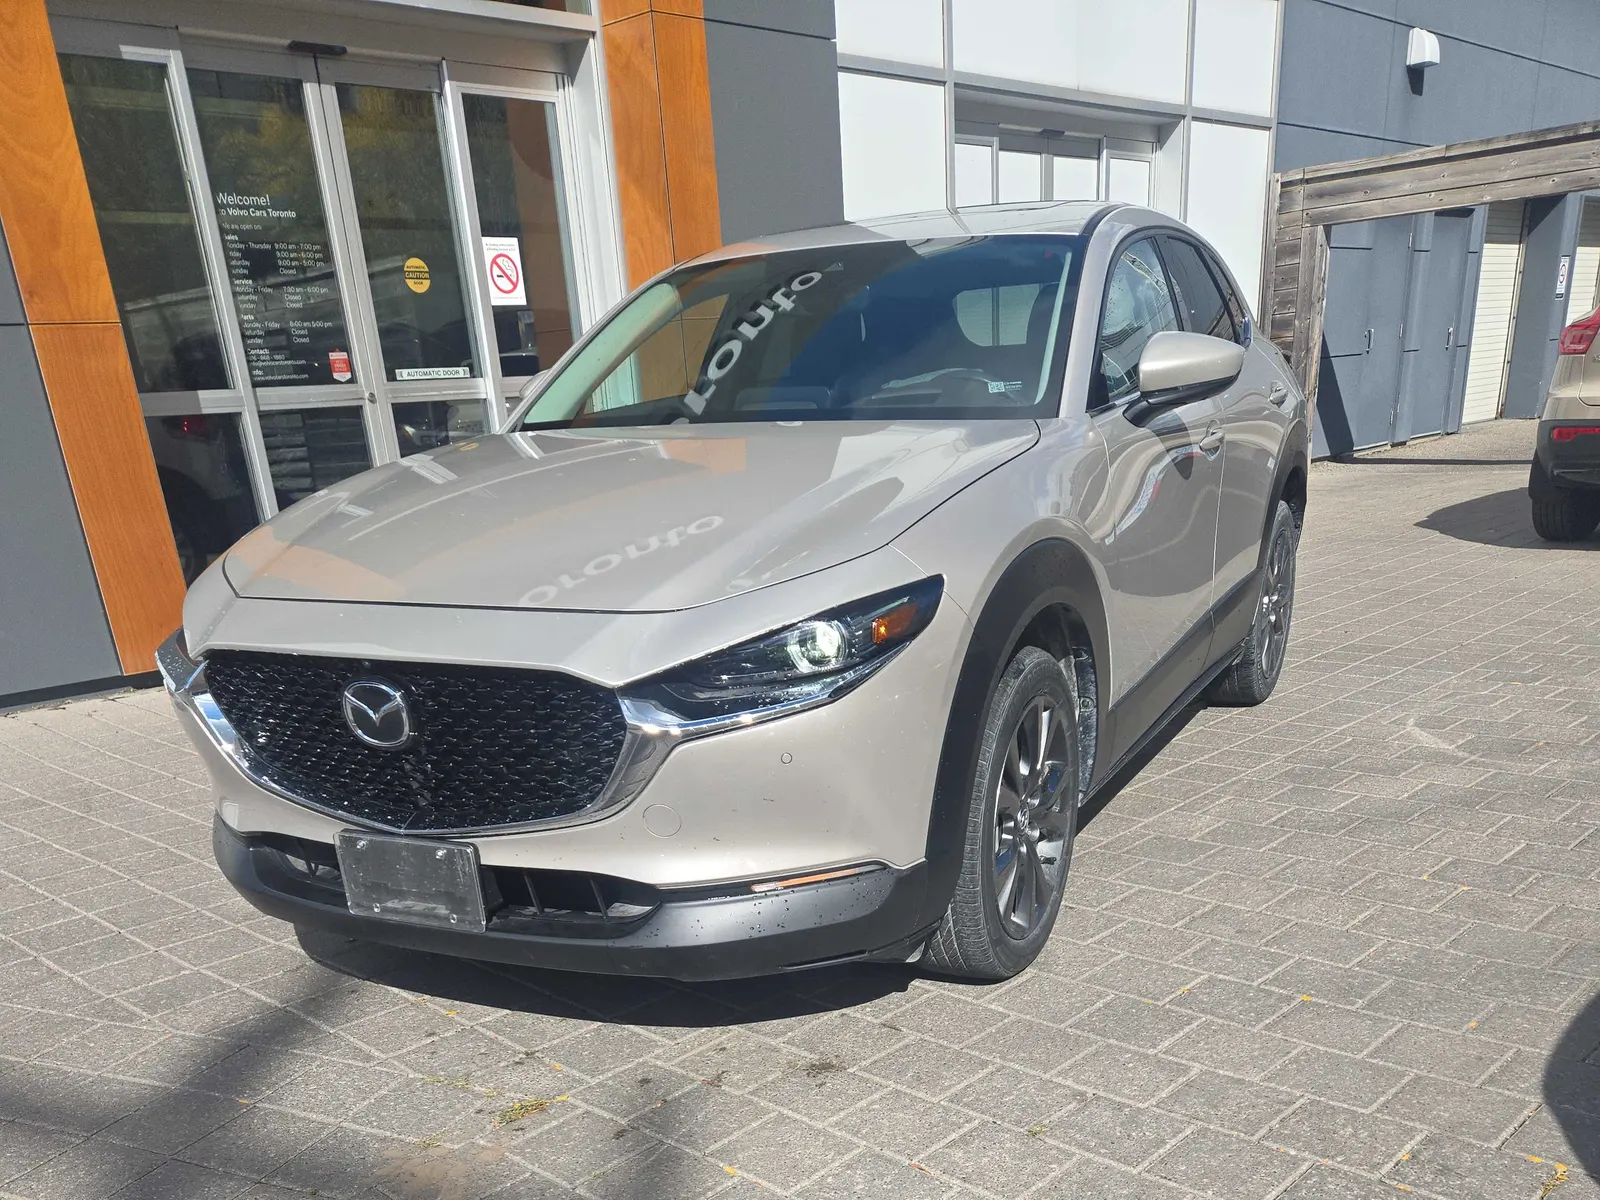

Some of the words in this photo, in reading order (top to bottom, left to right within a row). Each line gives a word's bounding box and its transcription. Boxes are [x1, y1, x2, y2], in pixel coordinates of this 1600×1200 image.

[216, 192, 270, 206] Welcome!
[227, 207, 249, 216] Volvo
[249, 208, 267, 217] Cars
[267, 208, 297, 218] Toronto
[240, 223, 253, 231] open
[249, 241, 272, 250] Thursday
[280, 267, 297, 275] Closed
[405, 271, 430, 279] CAUTION
[284, 293, 302, 301] Closed
[292, 336, 310, 344] Closed
[407, 369, 442, 377] AUTOMATIC
